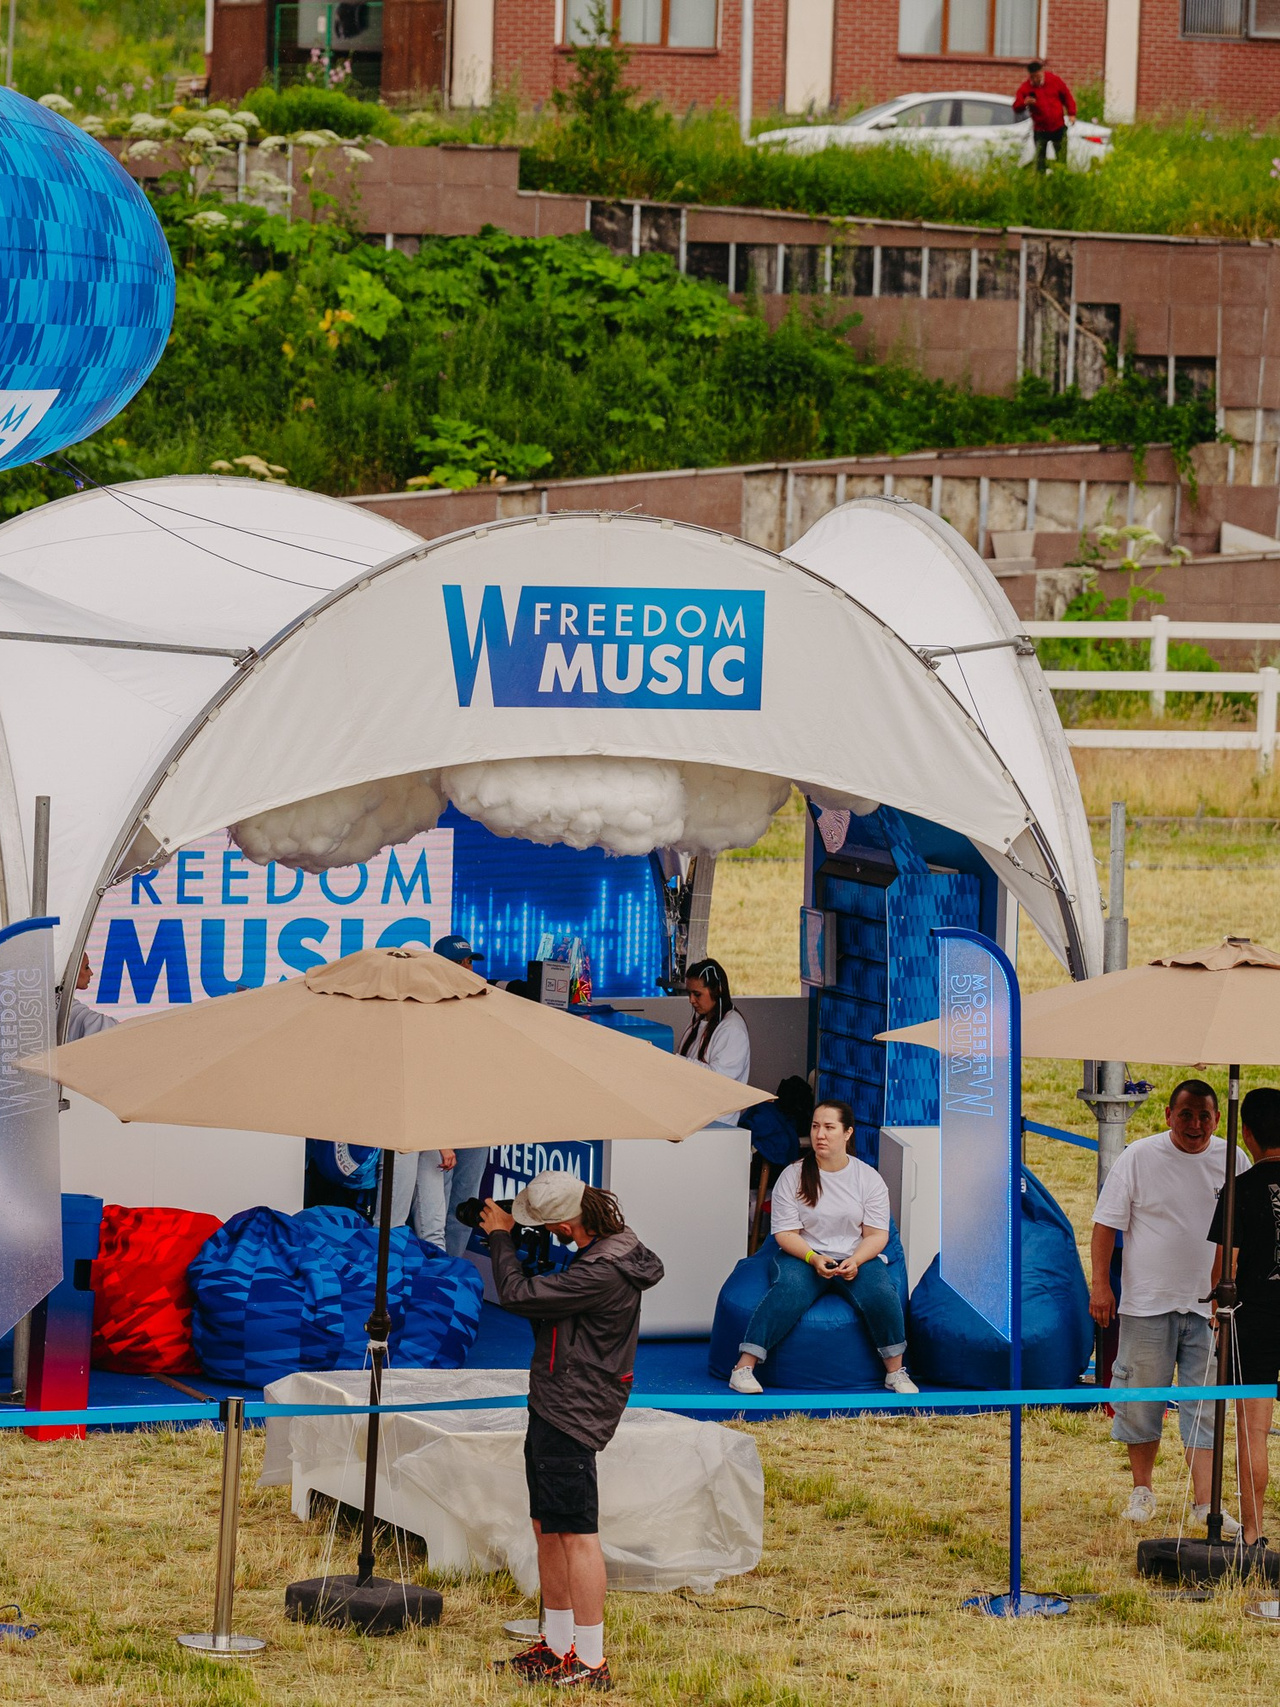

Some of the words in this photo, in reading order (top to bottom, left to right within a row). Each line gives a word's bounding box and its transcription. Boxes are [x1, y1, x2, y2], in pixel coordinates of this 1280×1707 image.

[533, 603, 746, 639] FREEDOM
[538, 642, 746, 696] MUSIC
[131, 847, 432, 905] REEDOM
[0, 969, 18, 1075] FREEDOM
[17, 968, 44, 1070] MUSIC
[489, 1143, 581, 1180] FREEDOM
